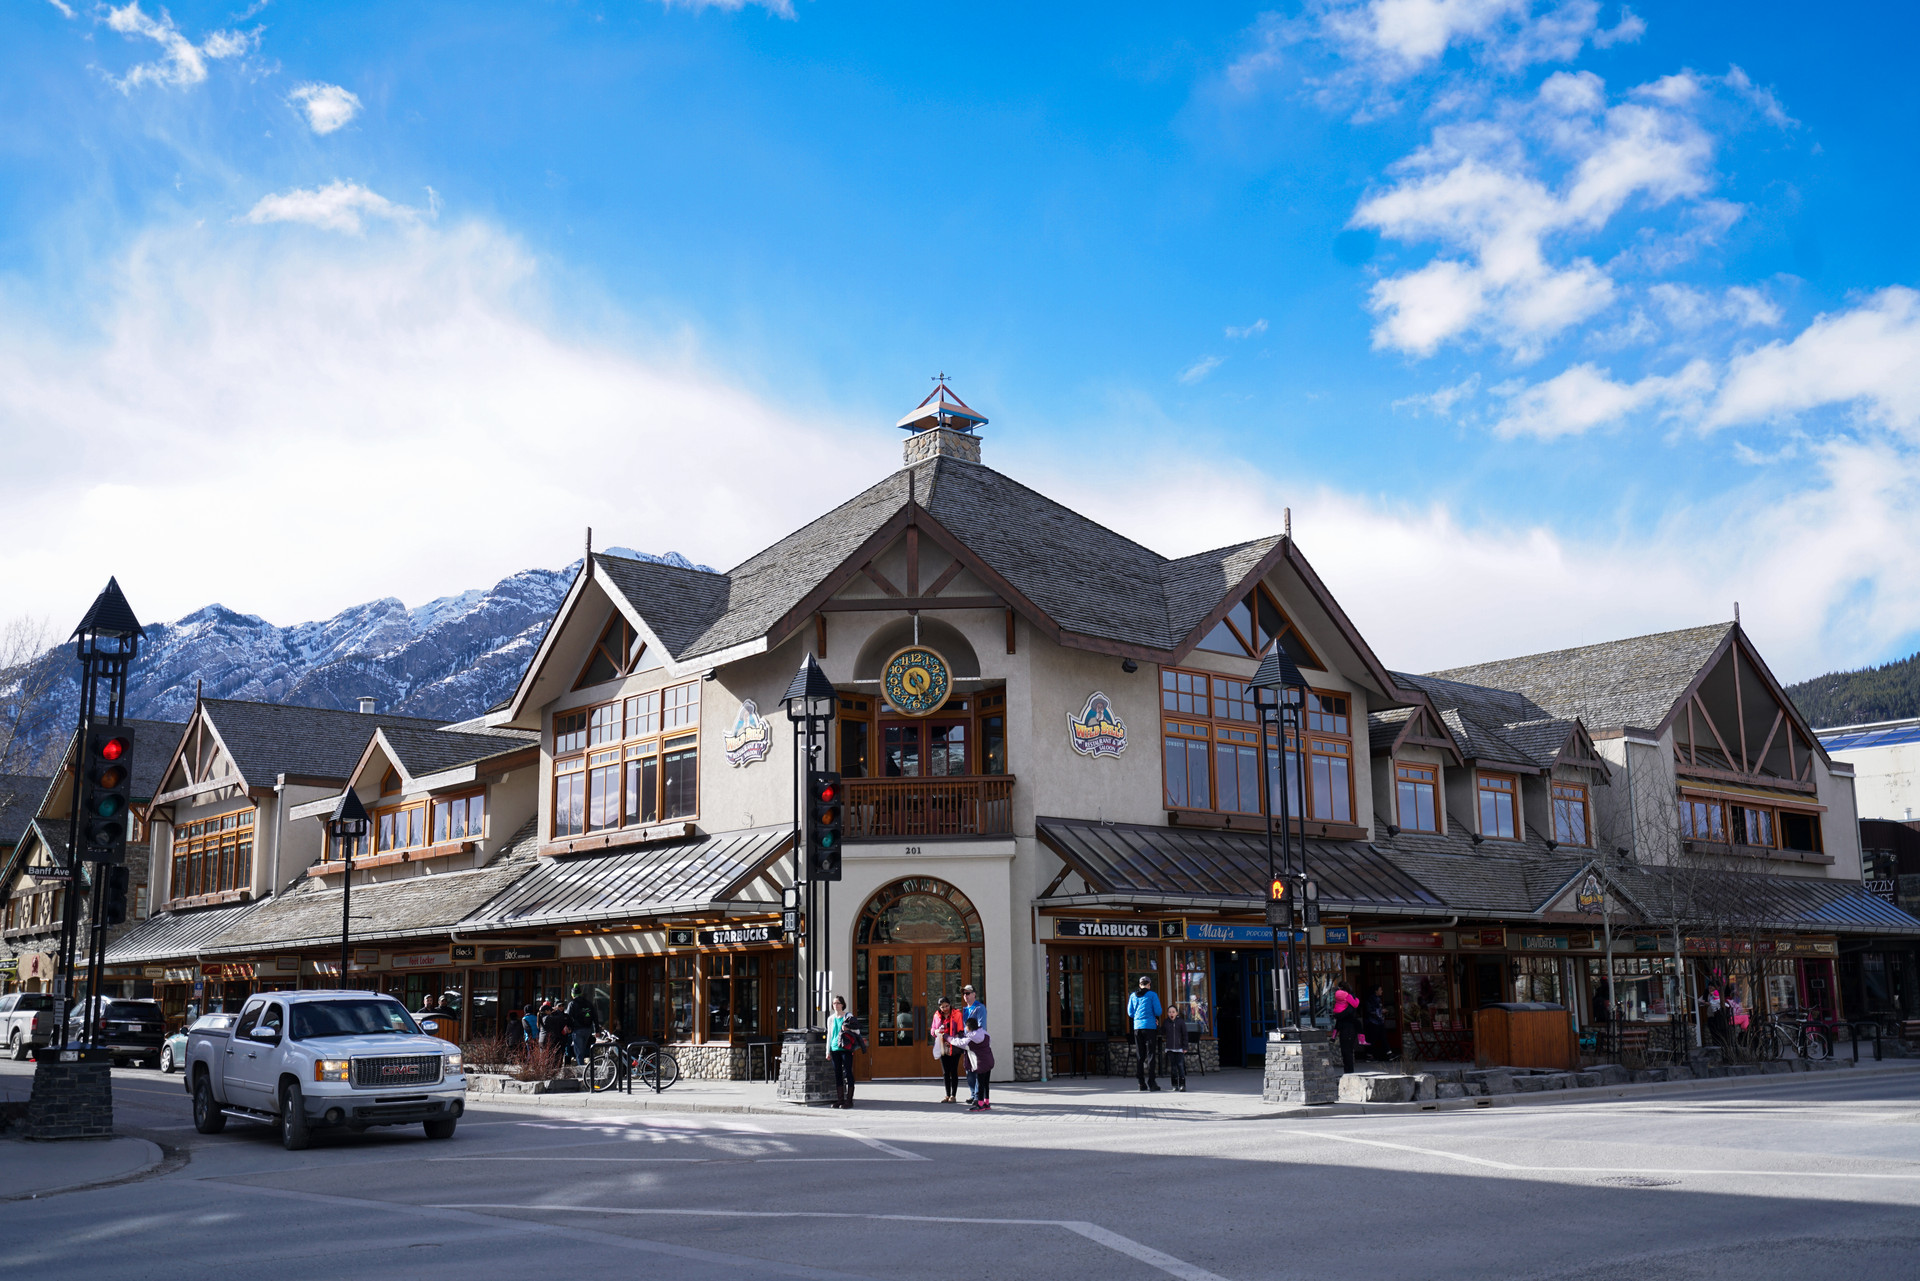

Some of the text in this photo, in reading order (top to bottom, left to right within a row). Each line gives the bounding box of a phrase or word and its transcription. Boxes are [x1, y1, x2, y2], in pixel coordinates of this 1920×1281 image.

[901, 656, 909, 665] 11
[911, 653, 921, 662] 12
[925, 656, 929, 664] 1
[891, 665, 902, 674] 10
[932, 664, 940, 673] 2
[890, 677, 898, 686] 9
[935, 676, 943, 685] 3
[893, 687, 901, 695] 8
[935, 687, 940, 695] 4
[901, 695, 909, 704] 7
[924, 695, 932, 703] 5
[912, 700, 920, 708] 6
[905, 846, 921, 855] 201
[28, 867, 70, 876] Banff Ave
[1864, 880, 1894, 892] RIZZLY
[1079, 923, 1148, 936] STARBUCKS
[1198, 924, 1235, 942] Mary's
[713, 928, 768, 943] STARBUCKS
[419, 955, 435, 965] Locker
[383, 1065, 418, 1075] GMC
